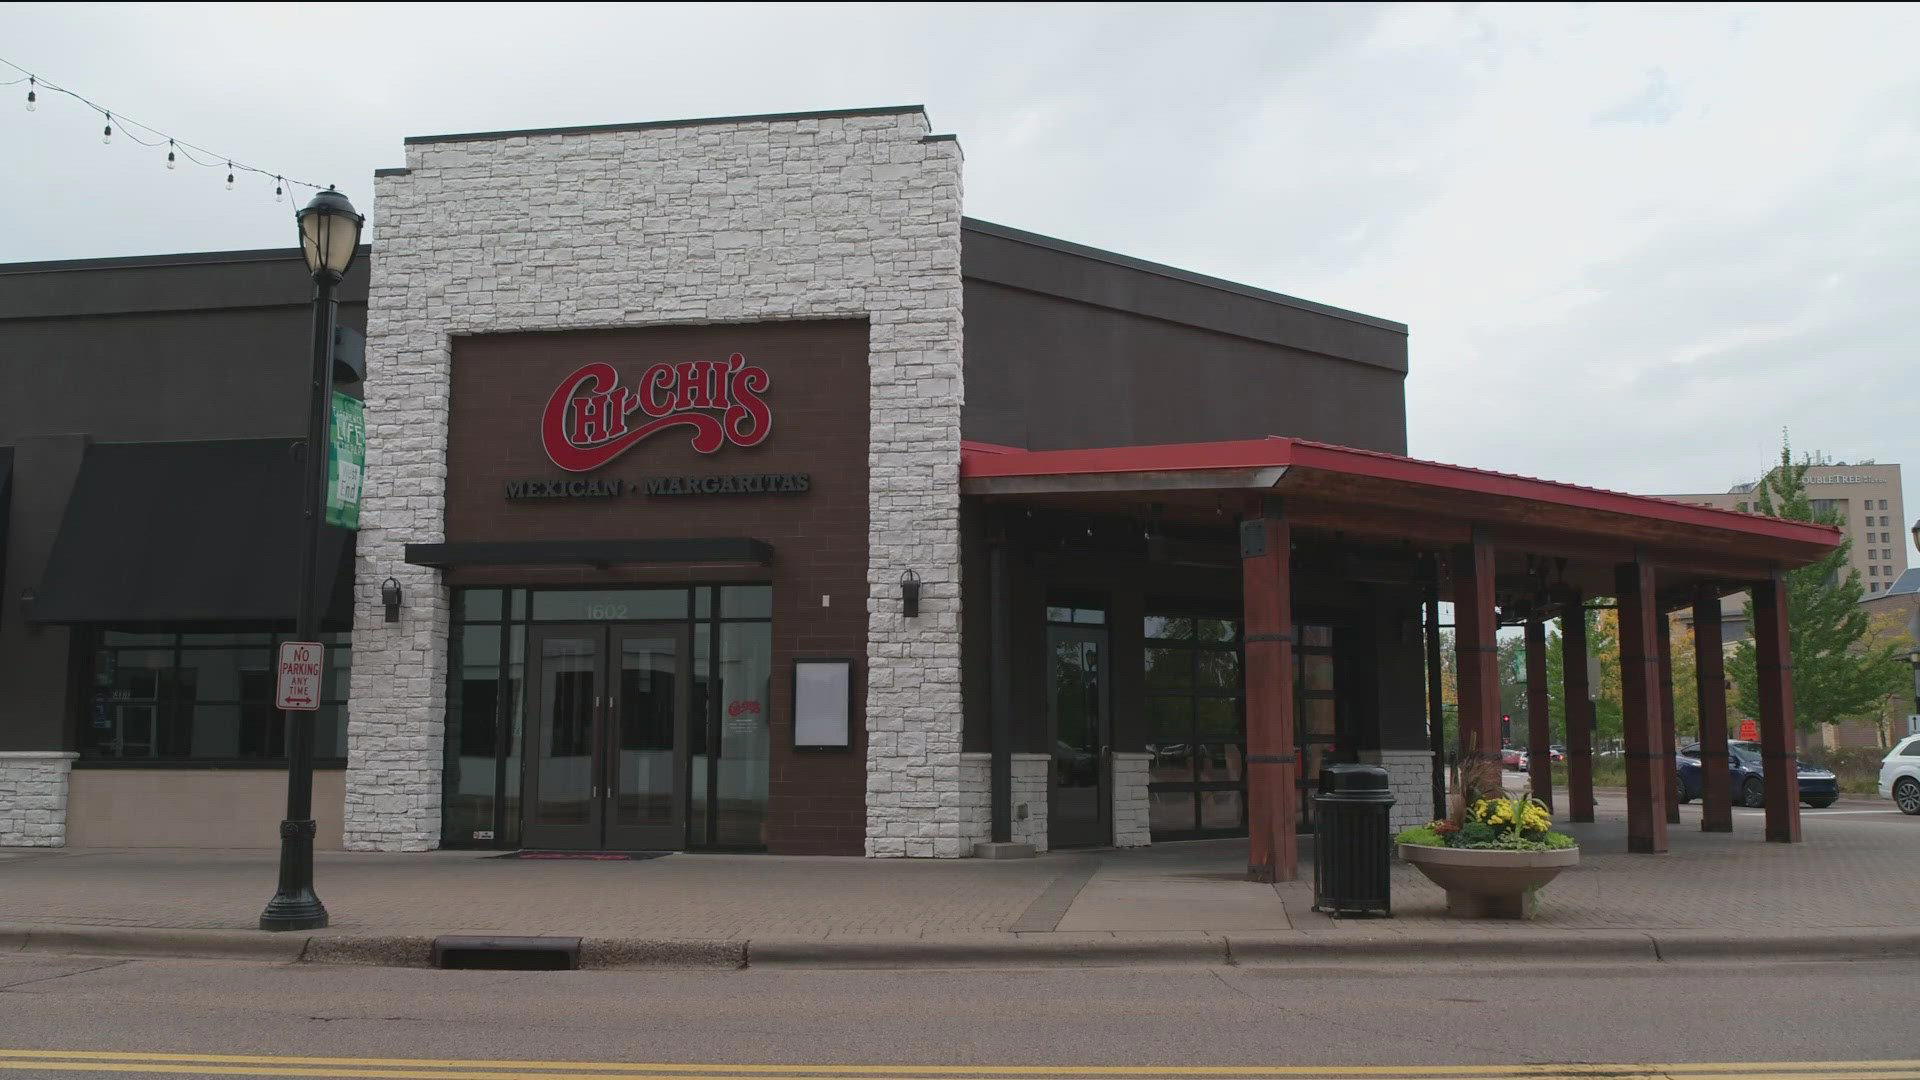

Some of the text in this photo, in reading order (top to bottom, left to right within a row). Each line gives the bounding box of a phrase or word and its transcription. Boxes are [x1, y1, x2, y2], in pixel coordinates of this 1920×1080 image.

[505, 472, 811, 499] MEXICAN MARGARITAS
[1797, 474, 1861, 485] OUBLETREE
[586, 604, 627, 619] 1602
[293, 649, 310, 662] NO
[282, 662, 319, 676] PARKING
[291, 676, 309, 686] ANY
[289, 686, 309, 696] TIME
